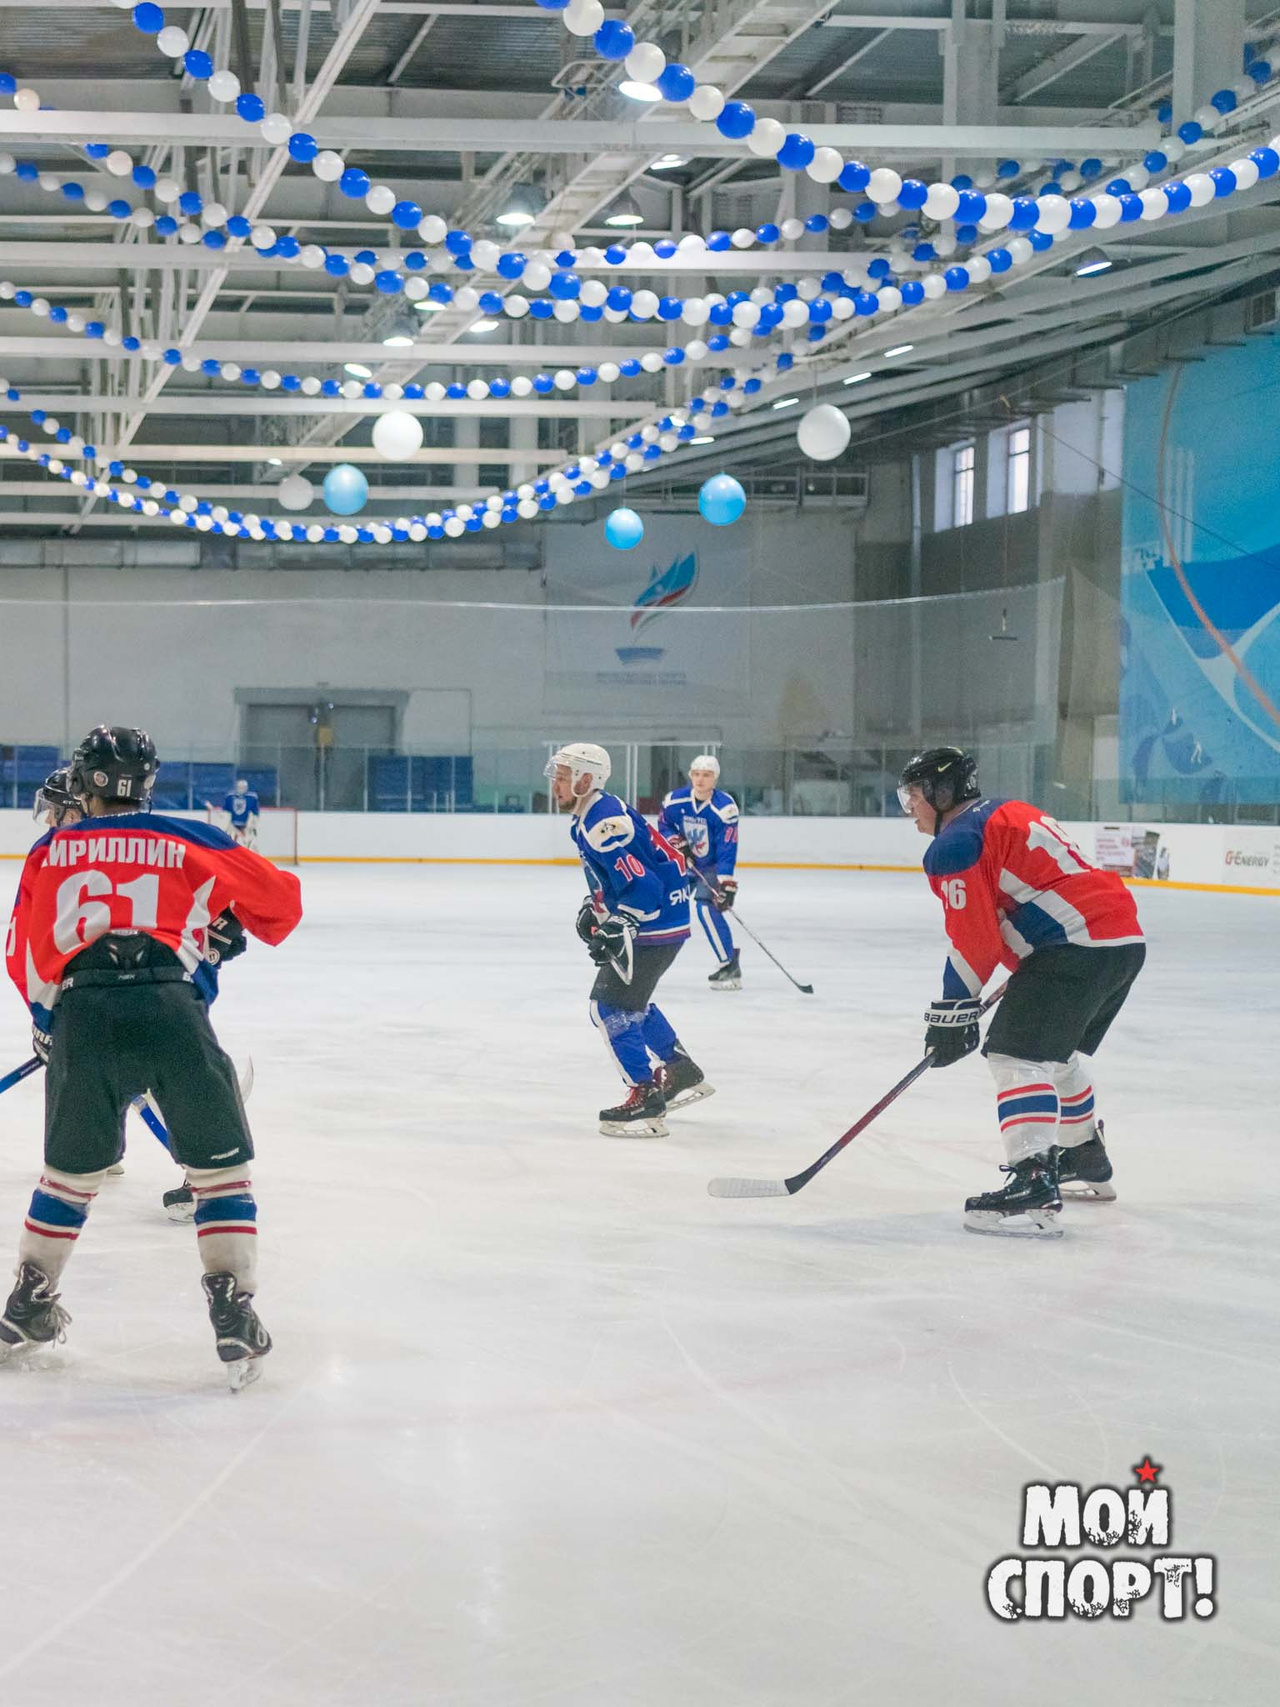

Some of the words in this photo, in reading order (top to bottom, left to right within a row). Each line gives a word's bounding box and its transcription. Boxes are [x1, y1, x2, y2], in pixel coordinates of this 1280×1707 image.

[117, 779, 132, 797] 61
[42, 837, 187, 869] ИРИЛЛИН
[614, 853, 646, 882] 10
[941, 879, 967, 910] 16
[53, 869, 160, 956] 61
[924, 1011, 979, 1024] BAUER
